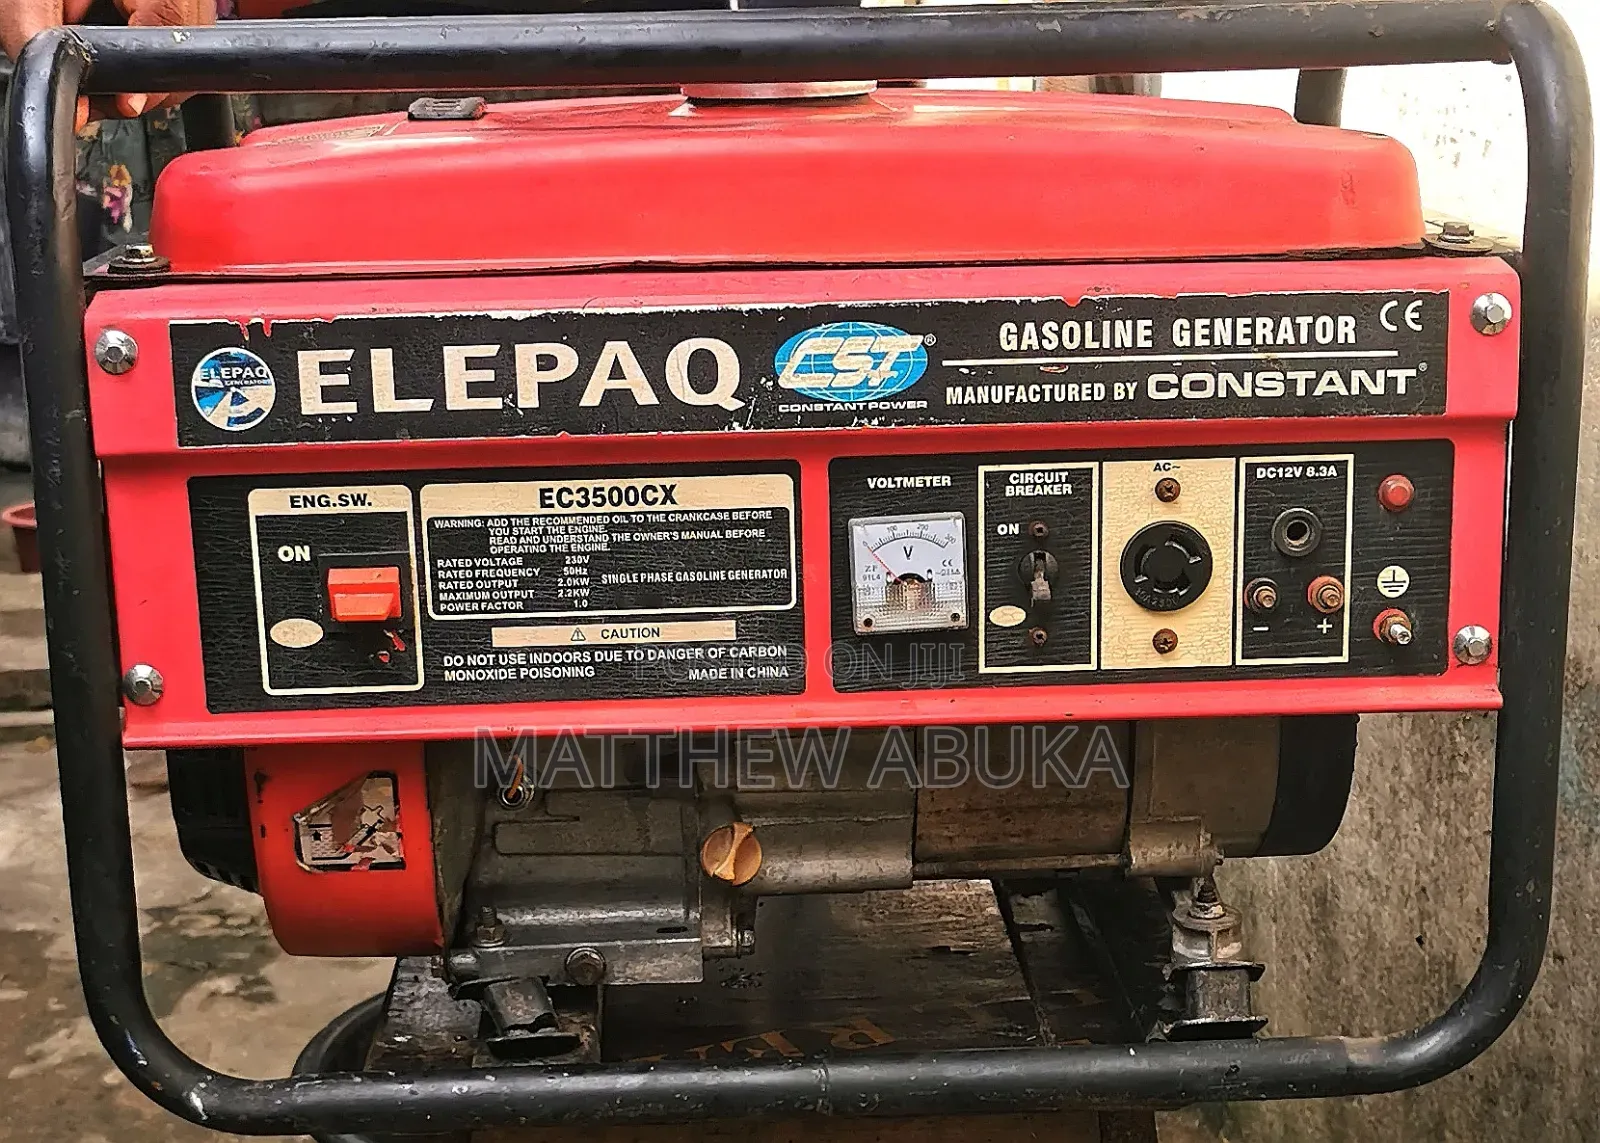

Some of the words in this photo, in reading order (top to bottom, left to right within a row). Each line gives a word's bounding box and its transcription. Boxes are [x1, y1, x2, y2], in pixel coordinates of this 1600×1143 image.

[999, 319, 1154, 351] GASOLINE
[1172, 315, 1357, 348] GENERATOR
[200, 366, 268, 380] ELEPAQ
[297, 338, 746, 416] ELEPAQ
[946, 383, 1106, 405] MANUFACTURED
[1113, 381, 1138, 401] BY
[1008, 471, 1069, 485] CIRCUIT
[1256, 467, 1303, 479] DC12V
[1306, 465, 1338, 478] 8.3A
[867, 475, 952, 489] VOLTMETER
[539, 484, 678, 508] EC3500CX
[1005, 484, 1073, 497] BREAKER
[289, 493, 373, 509] ENG.SW.
[434, 519, 485, 529] WARNING:
[487, 517, 508, 527] ADD
[510, 517, 530, 526] THE
[532, 515, 610, 526] RECOMMENDED
[611, 514, 629, 524] OIL
[630, 514, 645, 523] TO
[647, 513, 666, 523] THE
[668, 511, 730, 522] CRANKCASE
[732, 510, 773, 520] BEFORE
[488, 527, 510, 536] YOU
[512, 526, 544, 536] START
[546, 525, 566, 535] THE
[997, 523, 1020, 535] ON
[489, 536, 517, 546] READ
[519, 535, 541, 545] AND
[542, 532, 609, 544] UNDERSTAND
[611, 532, 631, 543] THE
[632, 531, 679, 541] OWNER'S
[681, 530, 724, 540] MANUAL
[725, 529, 766, 539] BEFORE
[277, 544, 311, 562] ON
[490, 544, 547, 555] OPERATING
[549, 544, 569, 553] THE
[437, 558, 472, 568] RATED
[474, 556, 523, 567] VOLTAGE
[565, 555, 590, 565] 230V
[438, 569, 473, 579] RATED
[475, 567, 541, 578] FREQUENCY
[563, 566, 588, 576] 50Hz
[601, 572, 639, 585] SINGLE
[641, 571, 674, 583] PHASE
[675, 570, 727, 582] GASOLINE
[728, 568, 788, 580] GENERATOR
[438, 581, 473, 590] RATED
[475, 578, 519, 589] OUTPUT
[557, 577, 590, 587] 2.0KW
[439, 591, 491, 601] MAXIMUM
[491, 589, 535, 600] OUTPUT
[557, 588, 590, 598] 2.2KW
[440, 602, 480, 612] POWER
[481, 601, 524, 611] FACTOR
[573, 600, 588, 608] 1.0
[601, 627, 660, 639] CAUTION
[443, 655, 464, 667] DO
[467, 654, 496, 666] NOT
[498, 653, 527, 665] USE
[529, 651, 591, 664] INDOORS
[594, 650, 623, 662] DUE
[626, 649, 645, 661] TO
[649, 647, 704, 660] DANGER
[707, 647, 727, 659] OF
[729, 645, 787, 658] CARBON
[444, 669, 517, 682] MONOXIDE
[520, 666, 595, 679] POISONING
[688, 668, 727, 681] MADE
[731, 668, 743, 679] IN
[747, 666, 789, 678] CHINA
